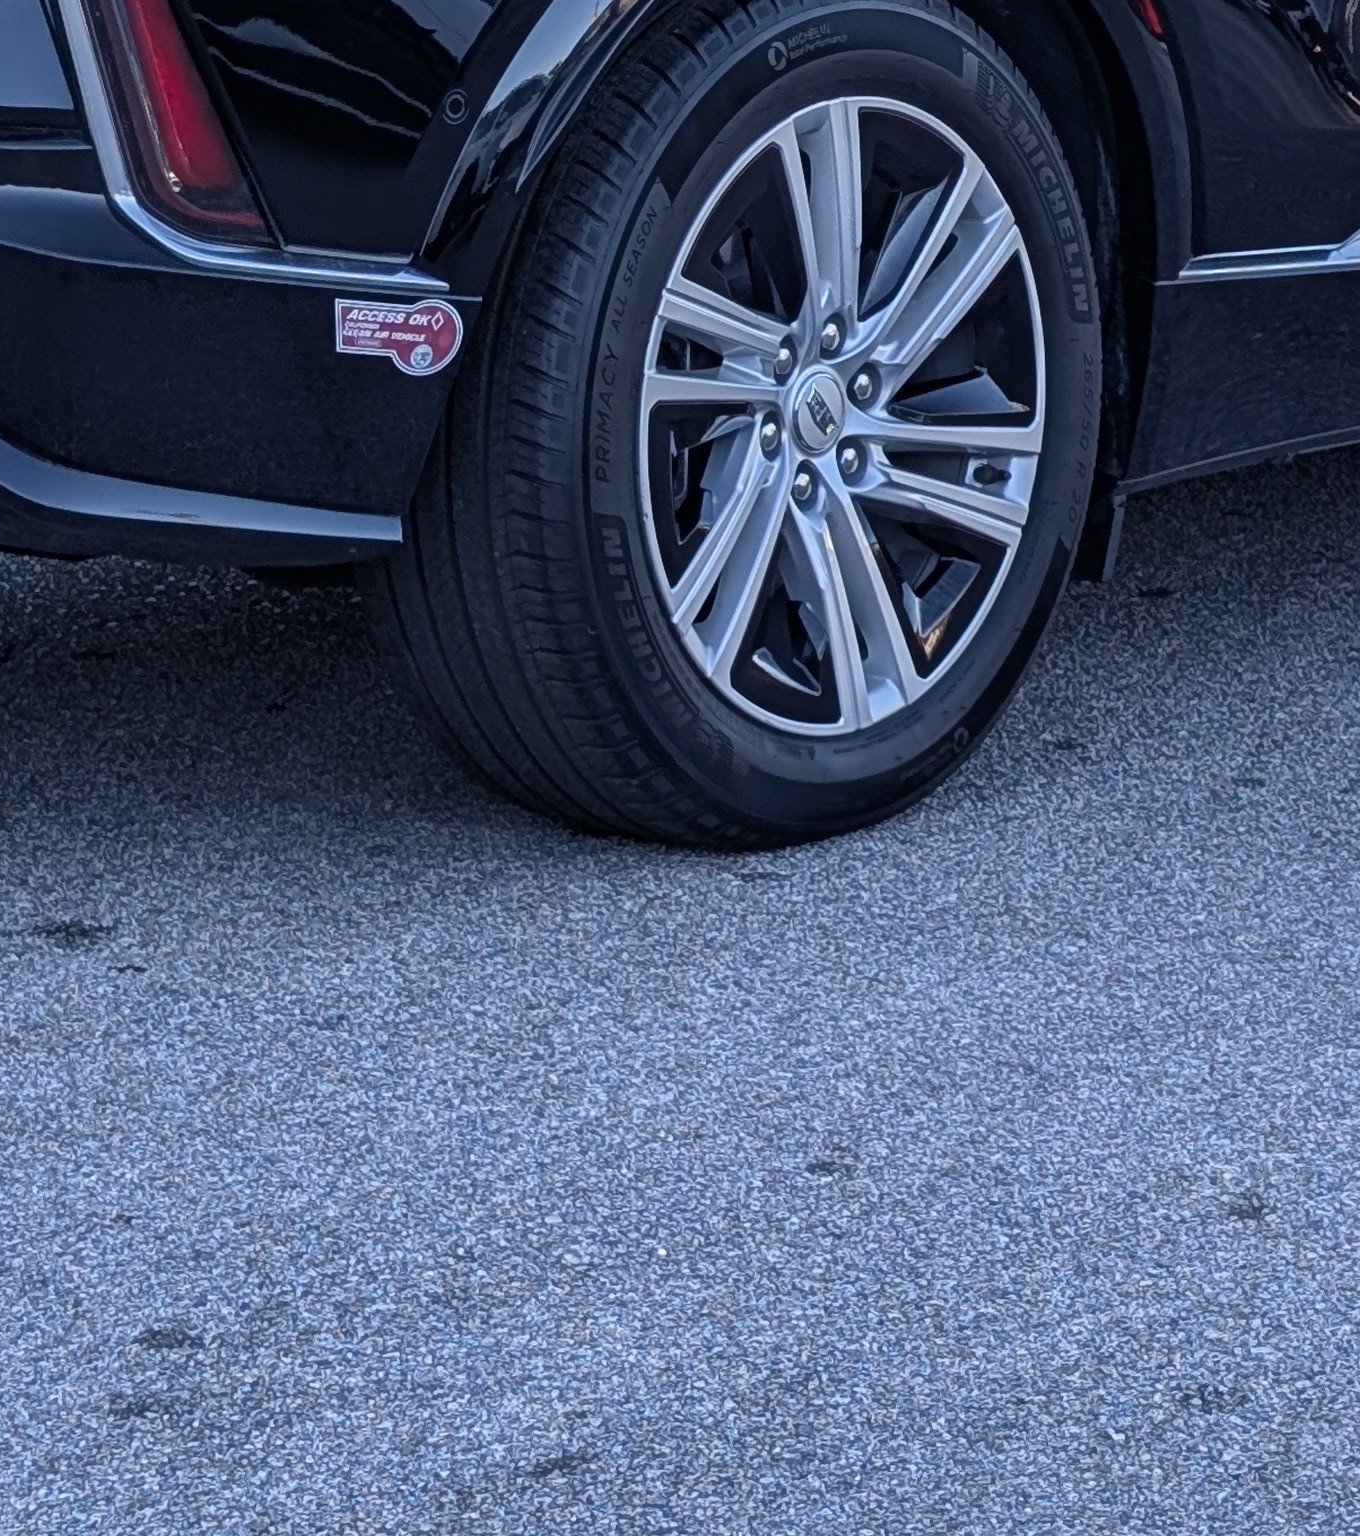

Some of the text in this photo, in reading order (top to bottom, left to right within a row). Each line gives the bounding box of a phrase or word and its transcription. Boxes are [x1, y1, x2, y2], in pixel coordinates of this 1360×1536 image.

[1013, 118, 1088, 312] MICHELIN
[346, 309, 432, 326] ACCESS OK
[594, 206, 658, 484] PRIMACY ALL SEASON
[602, 527, 691, 726] MICHELIN
